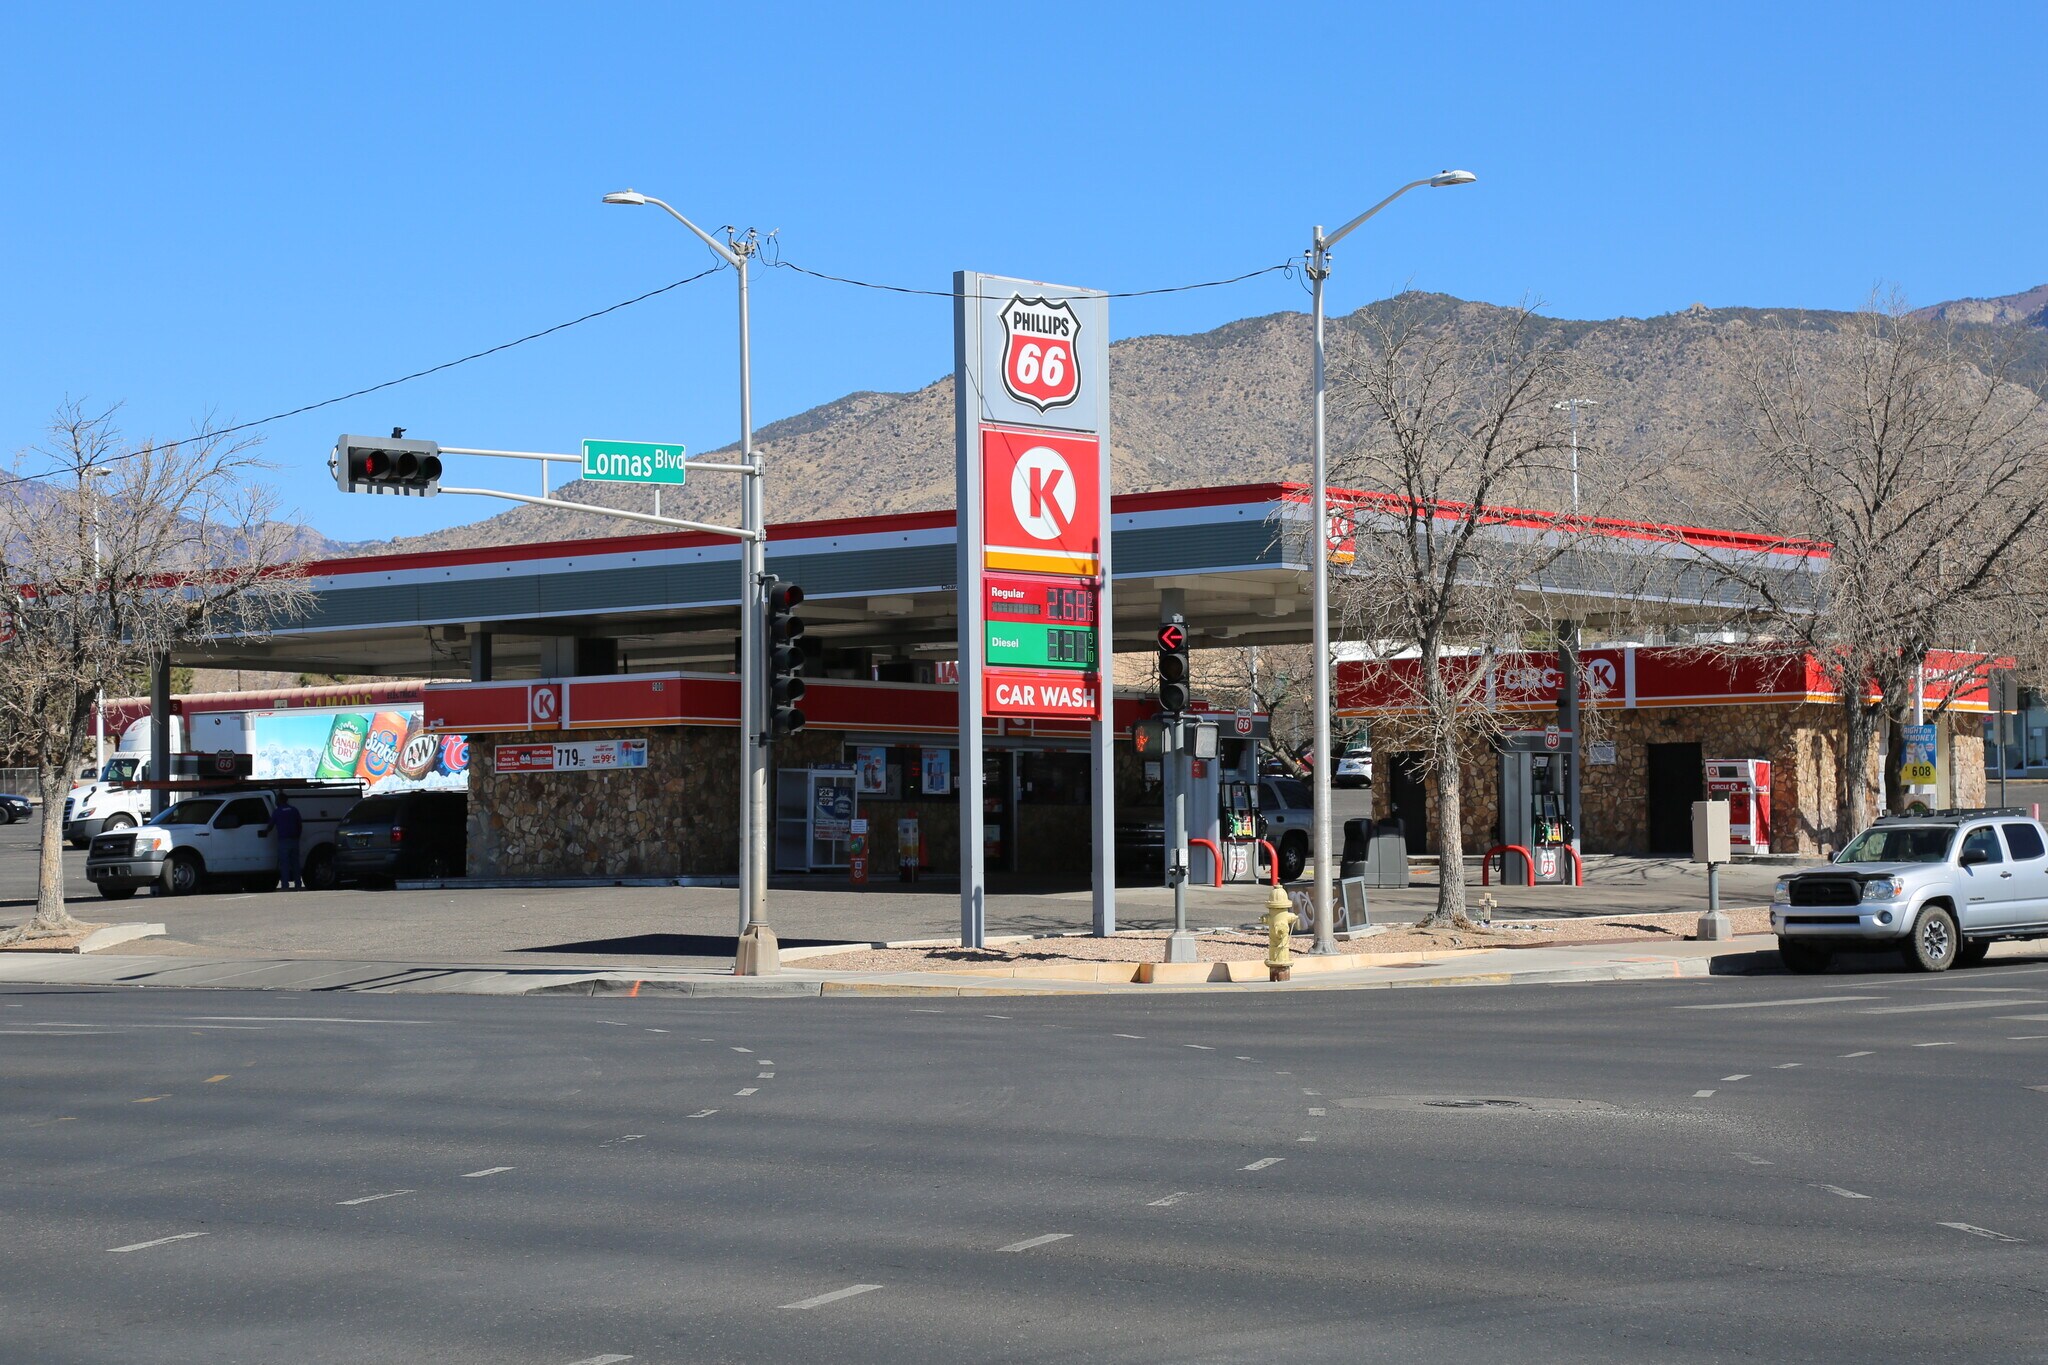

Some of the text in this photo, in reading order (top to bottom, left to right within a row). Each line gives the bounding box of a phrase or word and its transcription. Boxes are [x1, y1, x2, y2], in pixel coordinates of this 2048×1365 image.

[1013, 311, 1069, 337] PHILLIPS
[1016, 343, 1067, 387] 66
[584, 445, 685, 478] Lomas Blvd
[992, 587, 1024, 600] Regular
[992, 637, 1019, 648] Diesel
[1558, 676, 1563, 685] 2
[996, 684, 1094, 708] CAR WASH
[1238, 719, 1249, 730] 66
[1903, 727, 1923, 735] RIGHT
[332, 735, 359, 750] CANADA
[1547, 735, 1557, 744] 66
[337, 748, 354, 759] DRY
[219, 760, 231, 768] 66
